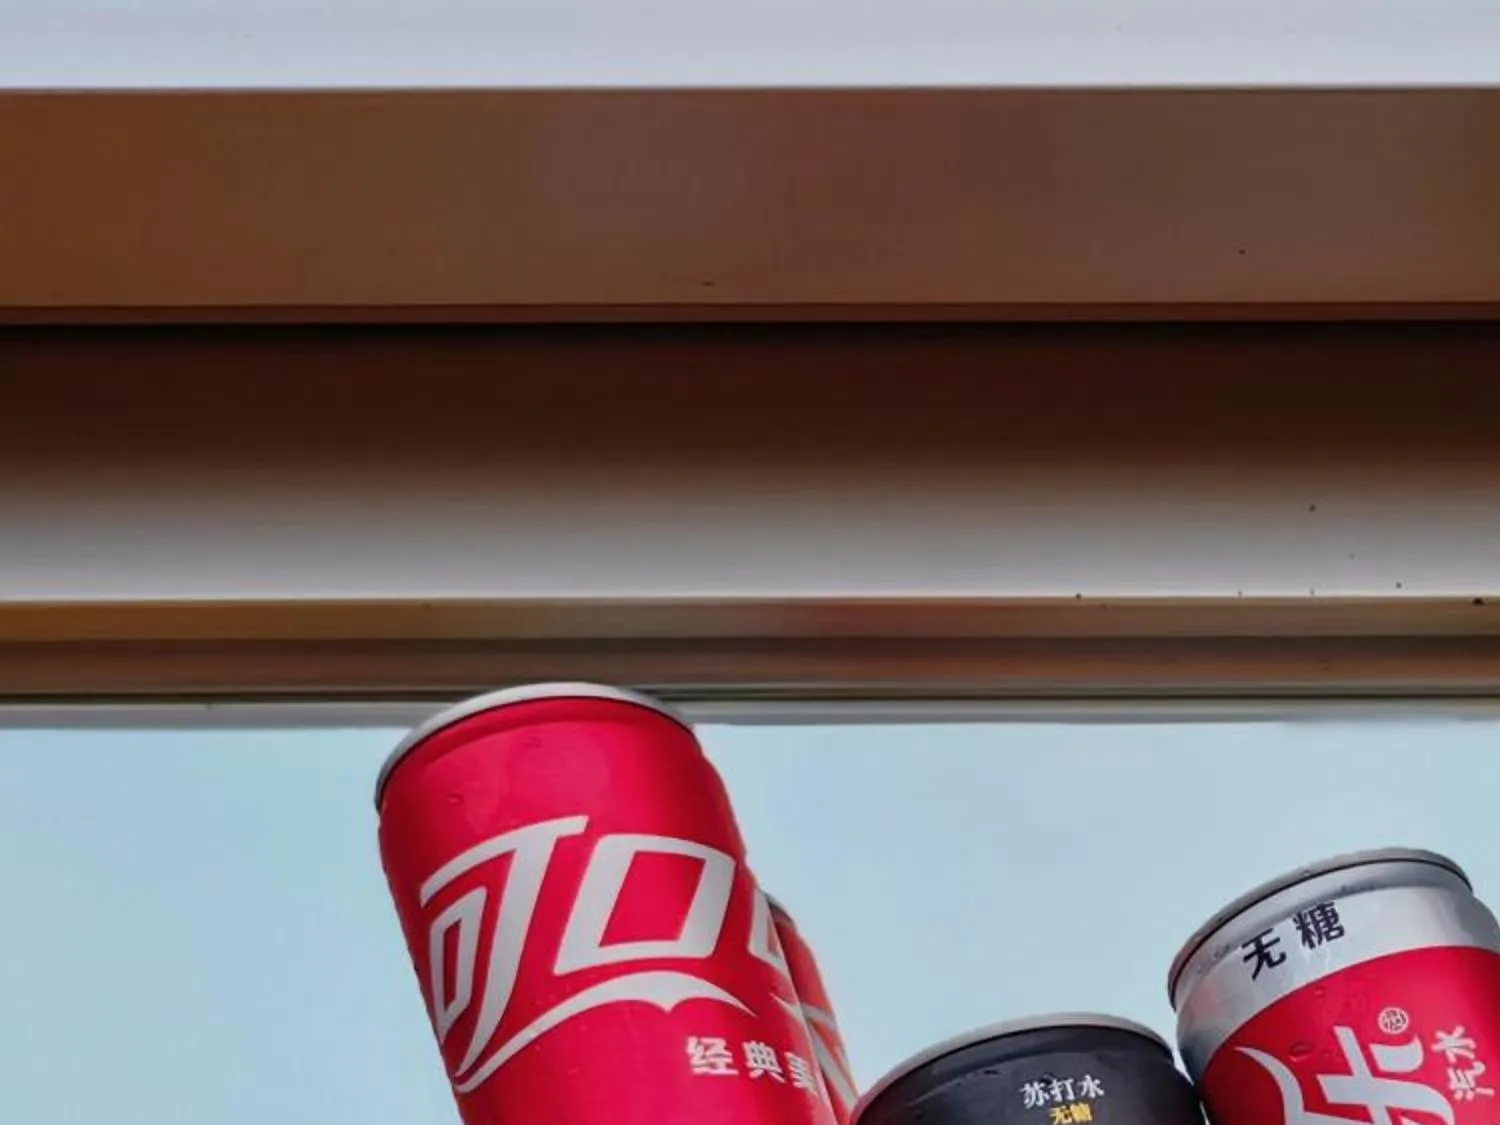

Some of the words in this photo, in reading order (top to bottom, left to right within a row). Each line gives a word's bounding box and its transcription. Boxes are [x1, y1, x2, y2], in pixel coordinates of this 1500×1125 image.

[1241, 899, 1346, 980] 无糖
[1020, 1074, 1105, 1109] 苏打水
[1049, 1102, 1093, 1125] 无糖
